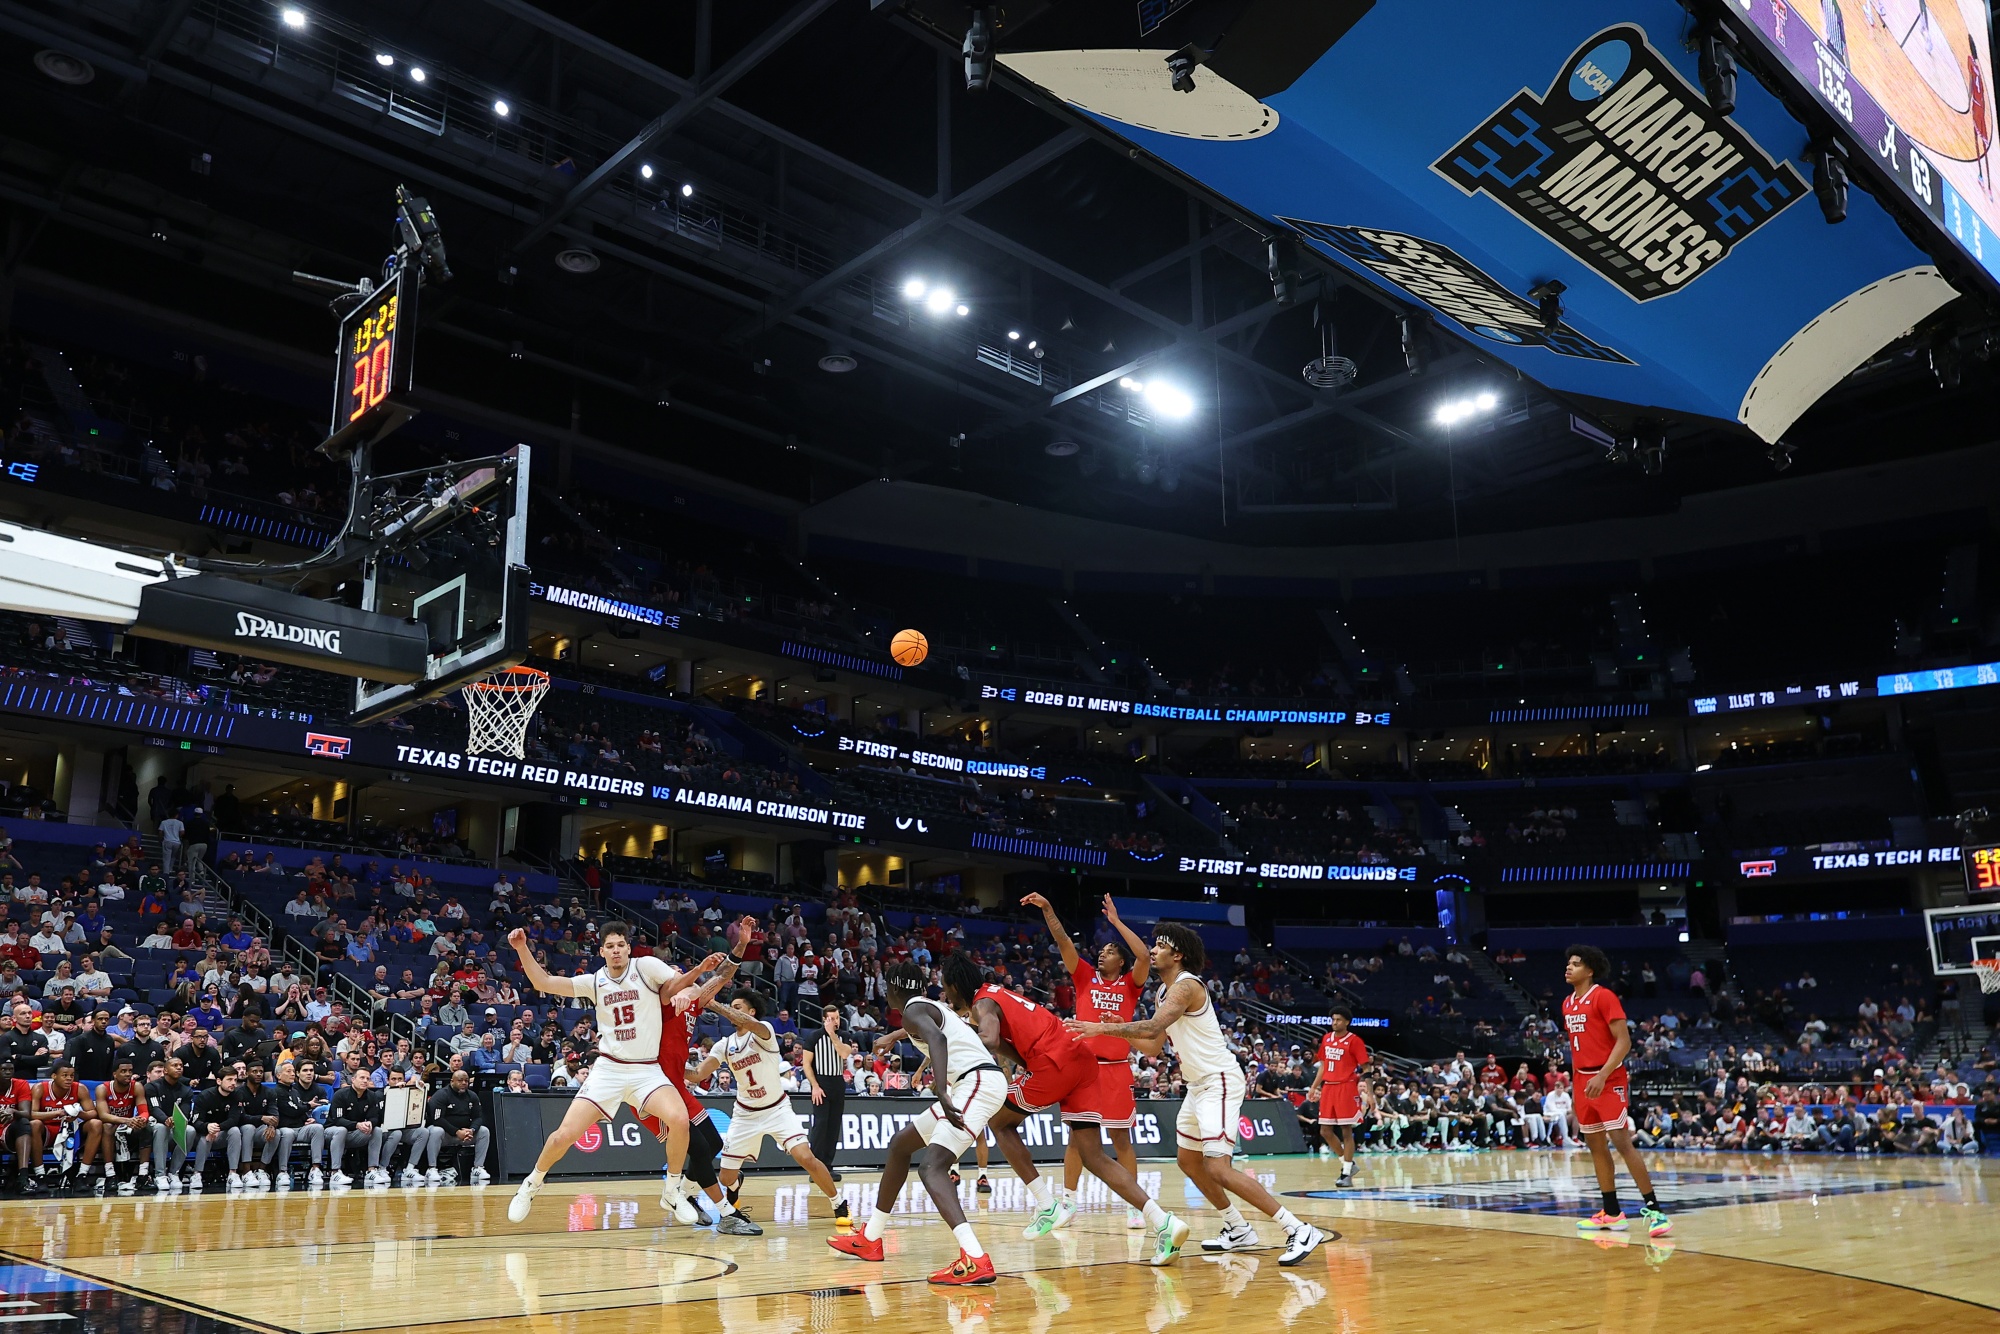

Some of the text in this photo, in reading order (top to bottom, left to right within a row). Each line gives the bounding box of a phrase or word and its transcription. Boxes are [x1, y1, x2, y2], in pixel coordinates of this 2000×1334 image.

[1819, 45, 1846, 82] 2ND HALF
[1575, 60, 1614, 96] NCAA
[1816, 57, 1853, 123] 13:23
[1585, 68, 1745, 201] MARCH
[1910, 148, 1932, 206] 63
[1539, 140, 1724, 286] MADNESS
[1360, 258, 1510, 330] MARCH
[354, 295, 398, 355] 13:23
[350, 339, 391, 422] 30
[235, 611, 342, 655] SPALDING
[582, 684, 595, 695] 202
[1728, 693, 1756, 709] ILLST
[1759, 691, 1775, 705] 78
[1815, 684, 1831, 699] 75
[1839, 681, 1859, 697] WF
[1024, 690, 1347, 724] 2026 DI MEN'S BASKETBALL CHAMPIONSHIP
[1694, 697, 1717, 707] NCAA
[1697, 705, 1717, 714] MEN
[152, 737, 165, 746] 130
[207, 745, 218, 754] 101
[856, 740, 898, 760] FIRST
[912, 750, 963, 772] SECOND
[966, 760, 1029, 779] ROUNDS
[397, 745, 866, 830] TEXAS TECH RED RAIDERS VS ALABAMA CRIMSON TIDE
[1198, 858, 1243, 875] FIRST
[1260, 863, 1323, 880] SECOND
[1327, 866, 1397, 881] ROUNDS
[1812, 853, 1870, 869] TEXAS
[1874, 850, 1922, 866] TECH
[603, 989, 640, 1006] CRIMSON
[1090, 989, 1124, 1003] TEXAS
[1092, 998, 1120, 1011] TECH
[612, 1004, 635, 1028] 15
[1565, 1013, 1587, 1026] TEXAS
[614, 1027, 636, 1042] TIDE
[1573, 1035, 1580, 1052] 4
[1328, 1060, 1335, 1072] 11
[745, 1069, 757, 1087] 1
[746, 1086, 767, 1099] TIDE
[606, 1122, 642, 1147] LG
[1253, 1118, 1275, 1137] LG
